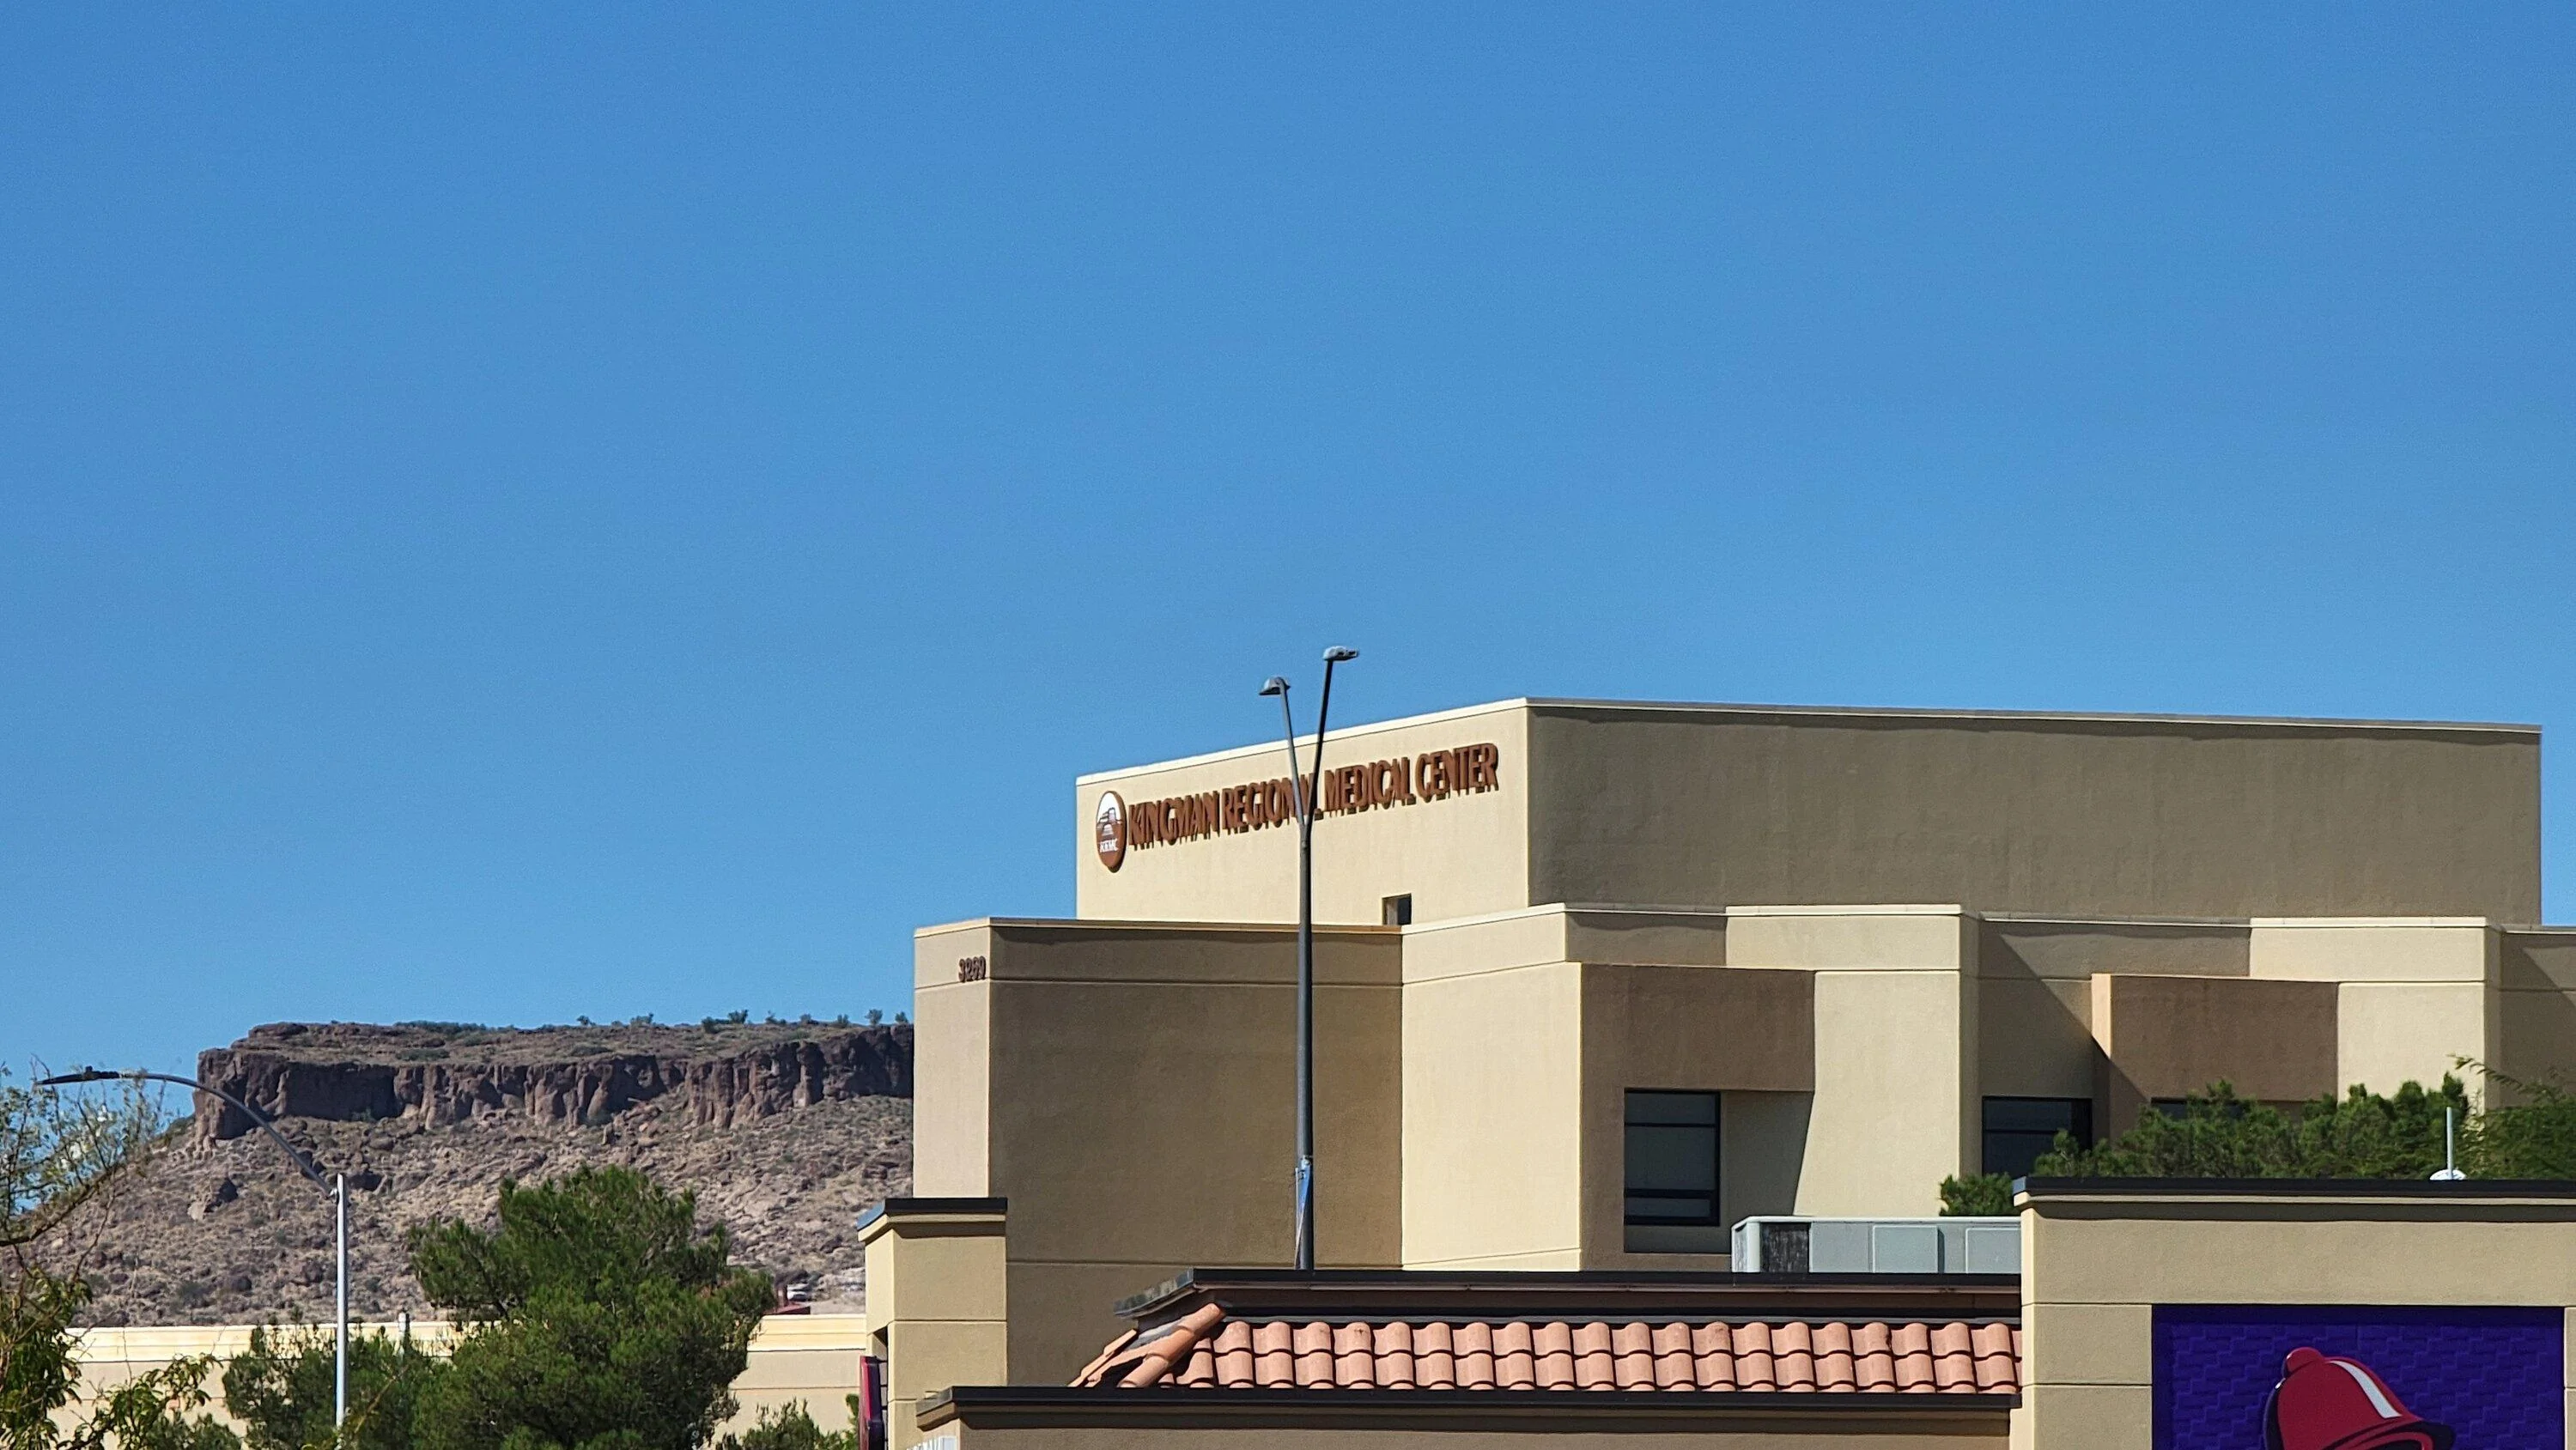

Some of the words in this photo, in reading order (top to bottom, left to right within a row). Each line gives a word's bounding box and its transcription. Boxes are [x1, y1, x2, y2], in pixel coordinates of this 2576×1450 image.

[1128, 791, 1219, 848] KINGMAN
[1324, 757, 1414, 814] MEDICAL
[1415, 743, 1498, 801] CENTER
